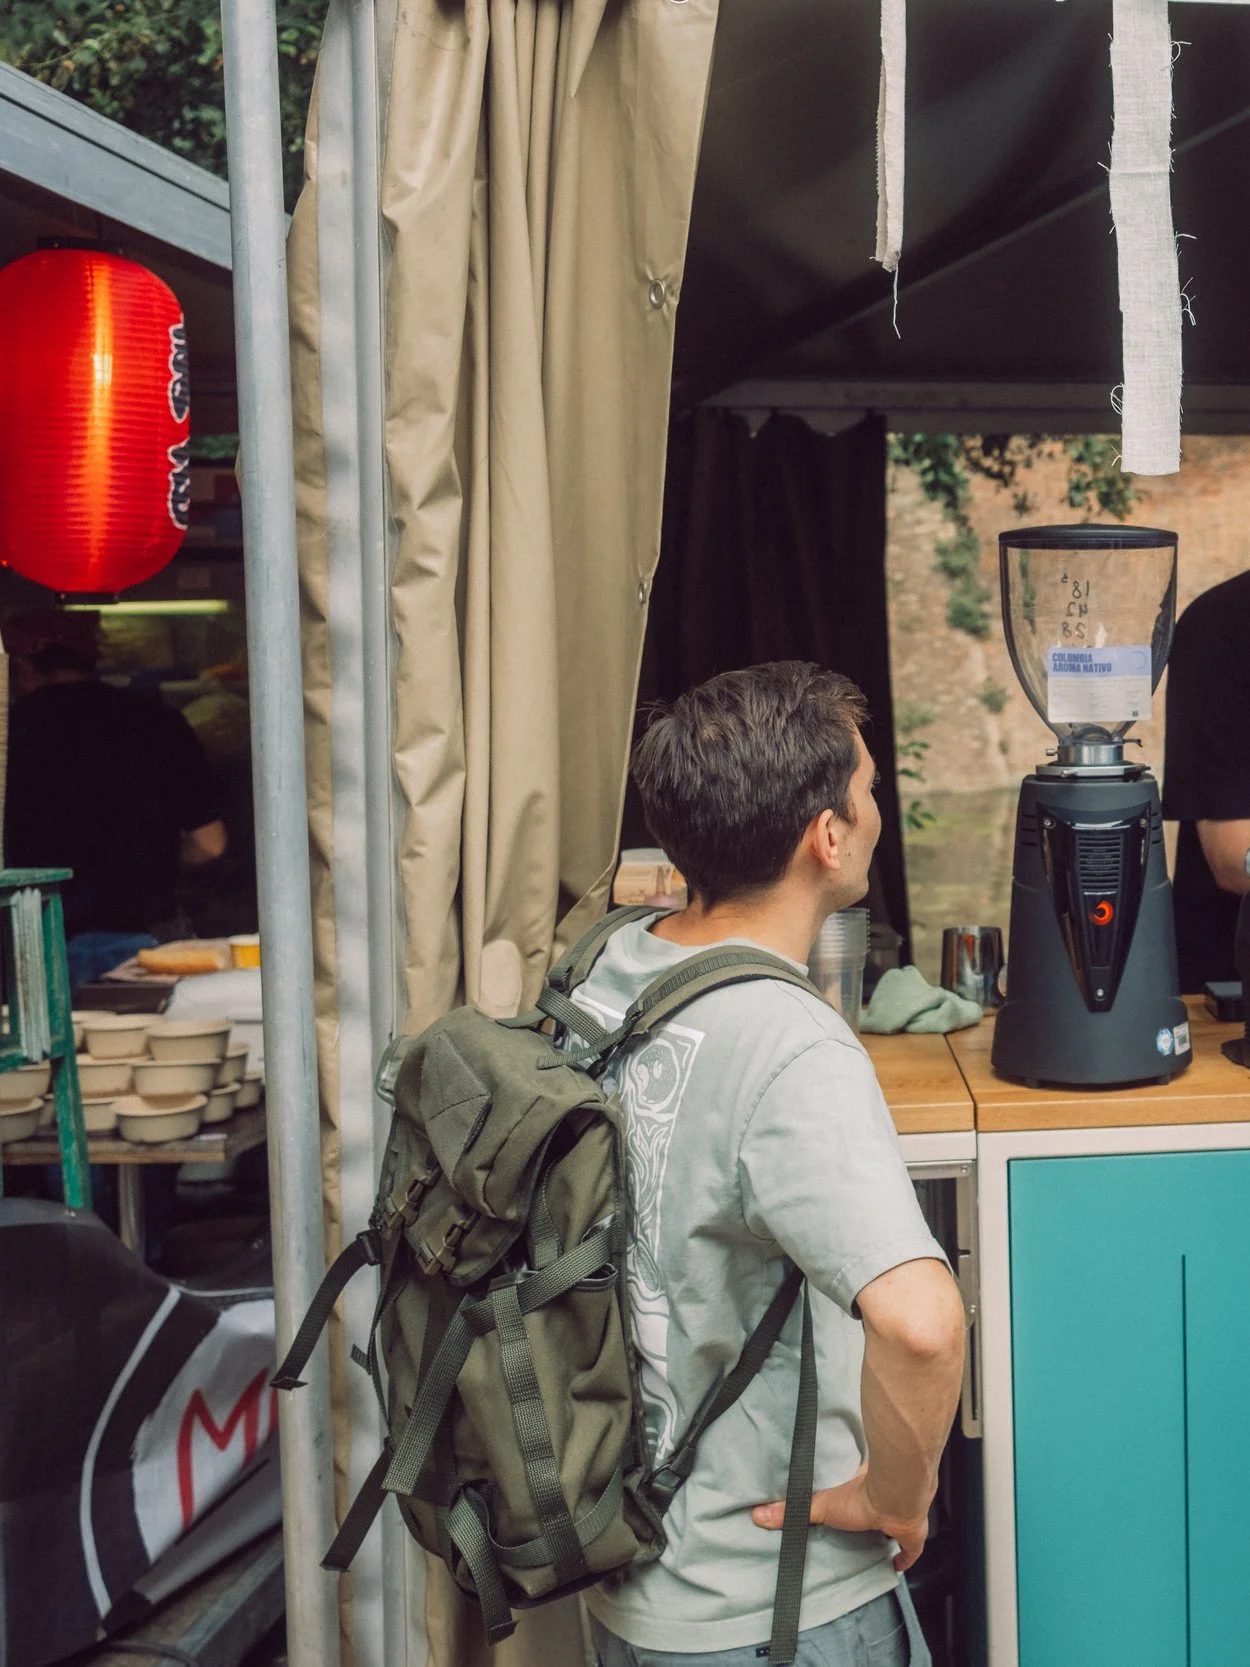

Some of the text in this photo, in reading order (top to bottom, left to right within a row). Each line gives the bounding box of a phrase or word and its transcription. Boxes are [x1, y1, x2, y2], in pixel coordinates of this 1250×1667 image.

[1052, 652, 1093, 663] COLOMBIA
[1052, 662, 1112, 673] AROMA NATIVO
